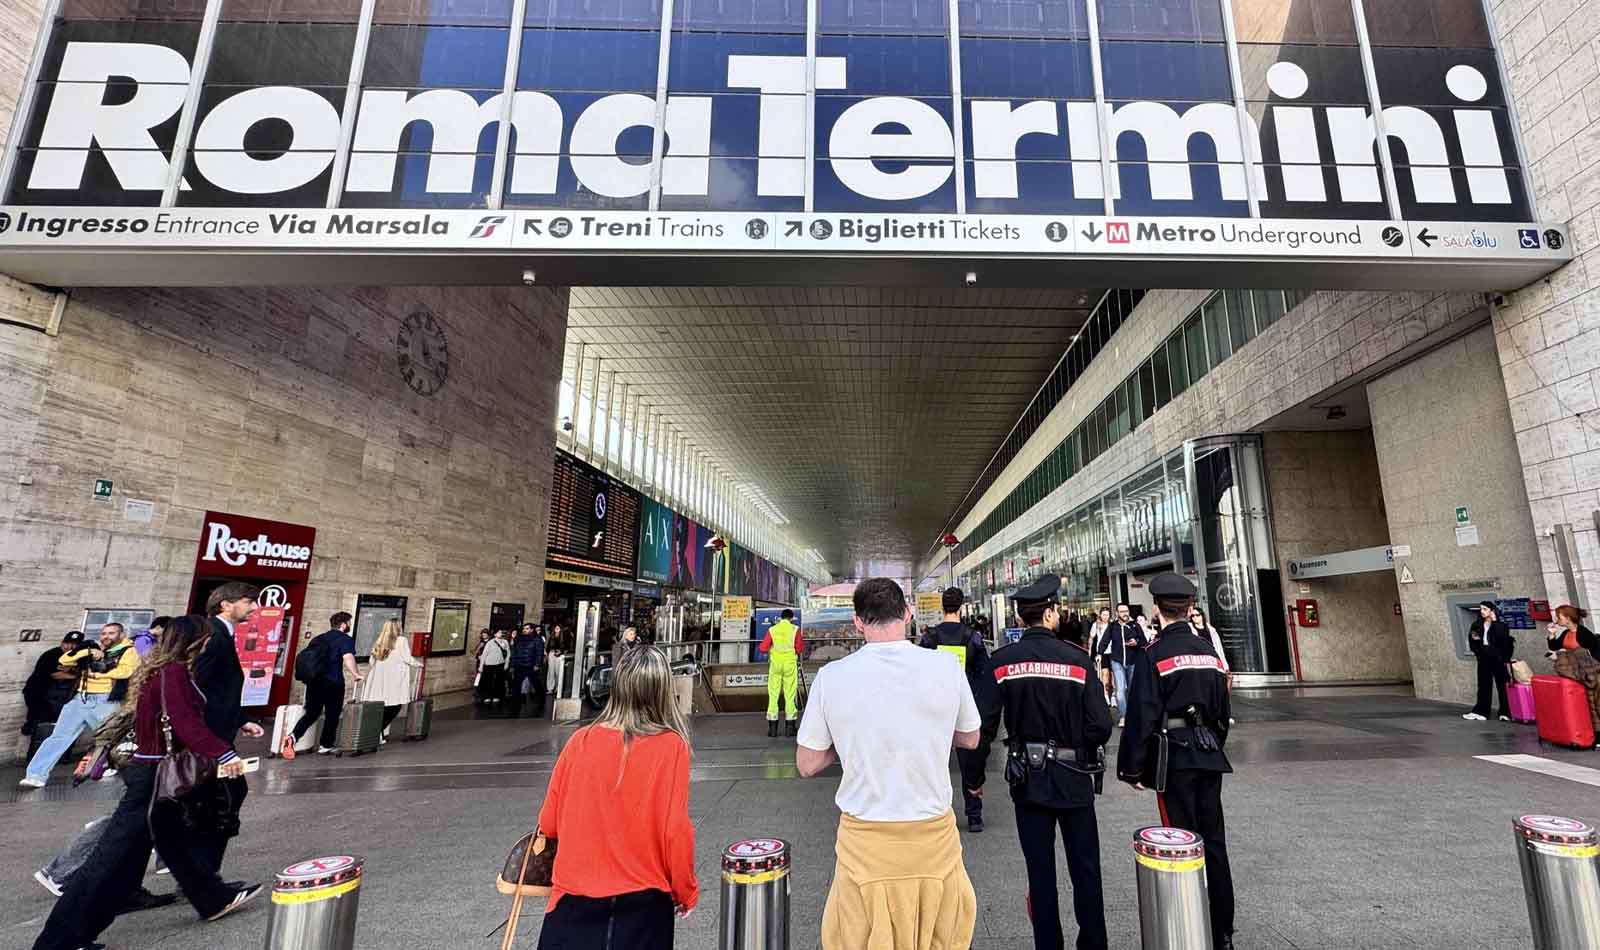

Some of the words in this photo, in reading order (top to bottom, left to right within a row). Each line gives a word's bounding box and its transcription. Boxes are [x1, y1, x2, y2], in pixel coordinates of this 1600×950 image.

[26, 40, 713, 198] Roma
[727, 54, 1513, 205] Termini
[16, 212, 149, 238] Ingresso
[154, 213, 260, 234] Entrance
[269, 213, 316, 234] Via
[326, 214, 449, 235] Marsala
[580, 216, 651, 237] Treni
[657, 217, 724, 237] Trains
[839, 218, 945, 243] Biglietti
[950, 219, 1021, 240] Tickets
[1108, 225, 1128, 241] M
[1136, 222, 1216, 242] Metro
[1220, 223, 1362, 249] Underground
[202, 522, 311, 566] Roadhouse
[257, 558, 309, 570] RESTAURANT
[1007, 662, 1071, 676] CARABINIERI
